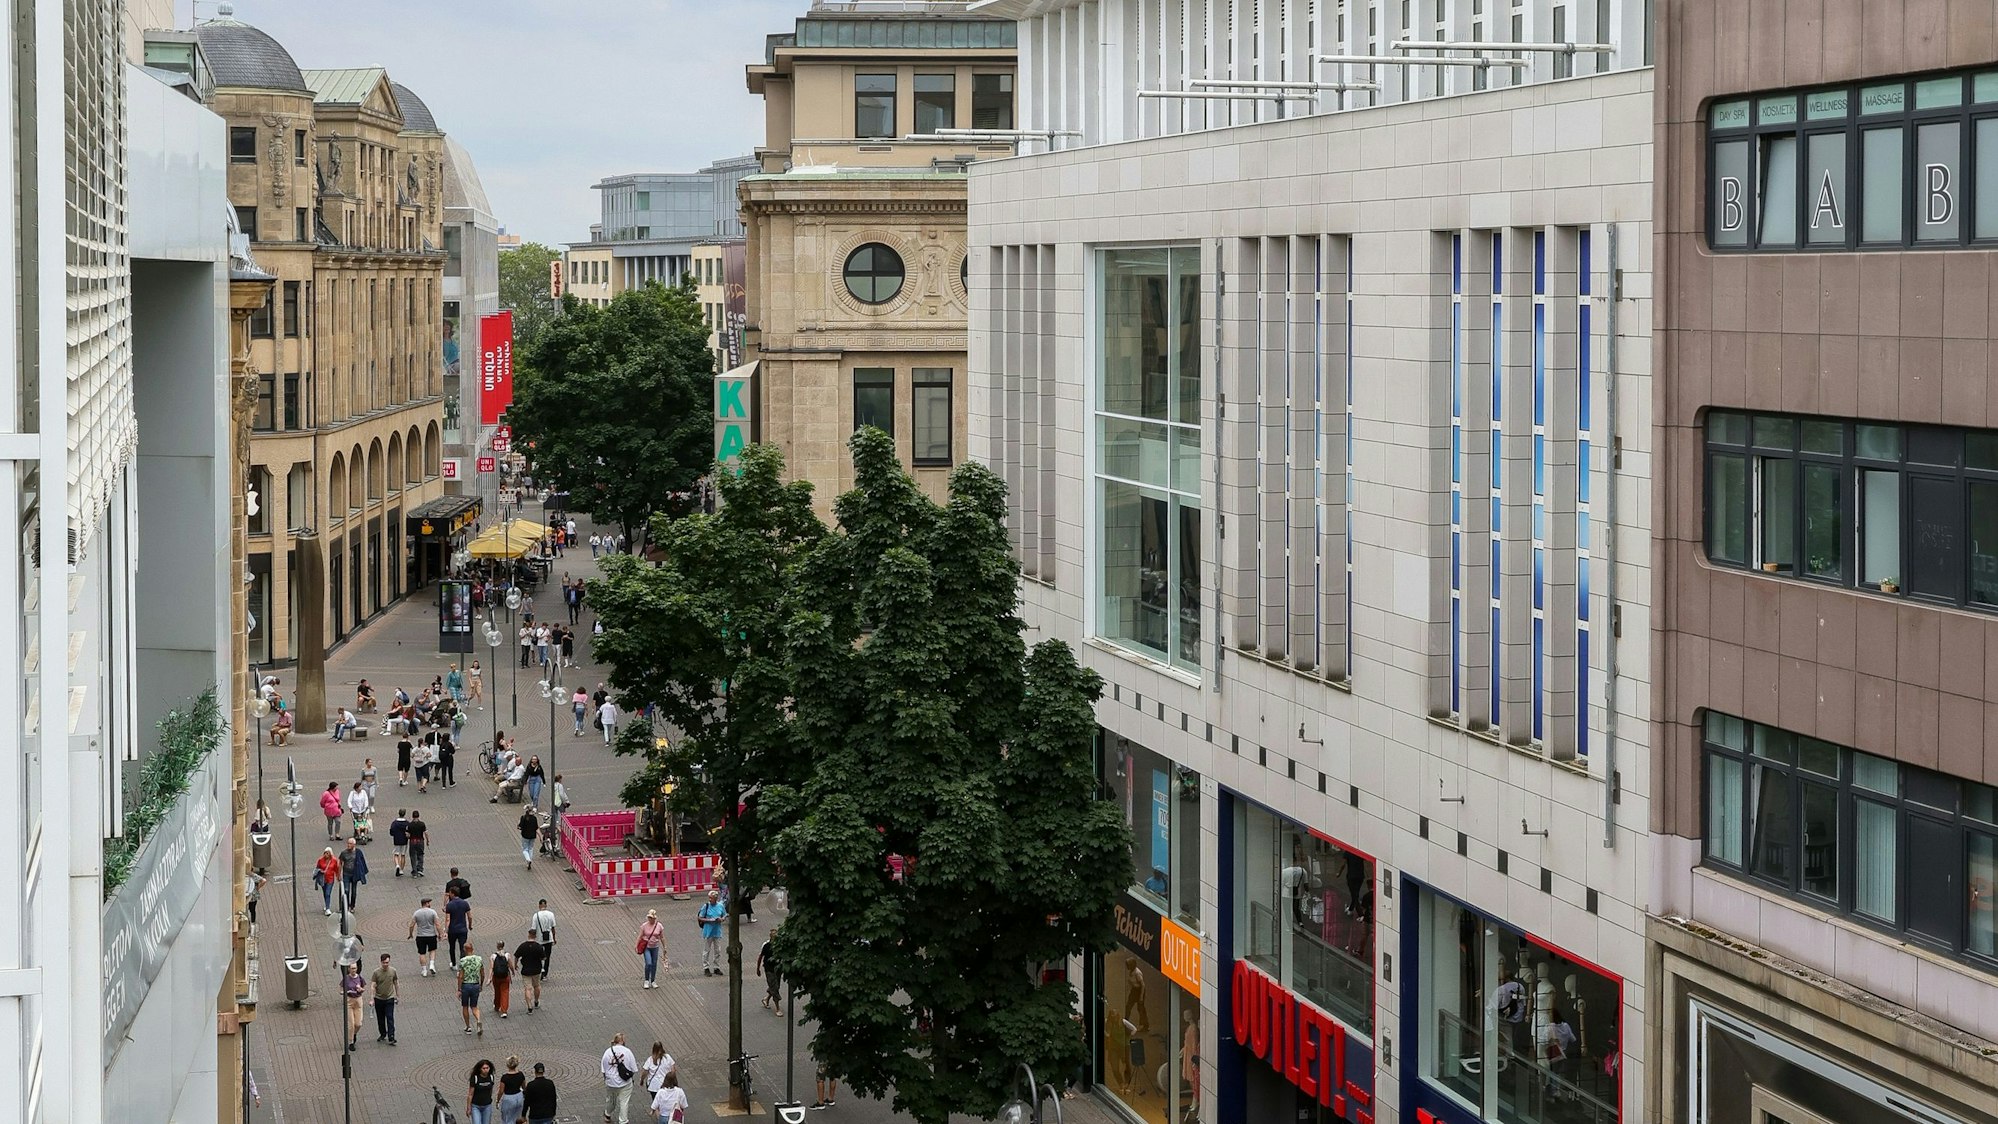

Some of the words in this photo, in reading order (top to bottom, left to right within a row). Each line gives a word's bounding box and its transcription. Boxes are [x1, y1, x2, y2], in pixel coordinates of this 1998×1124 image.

[1762, 103, 1797, 117] KOSMETIK
[1809, 99, 1848, 113] WELLNESS
[1865, 92, 1903, 107] MASSAGE
[1719, 110, 1731, 121] DAY
[1732, 108, 1746, 120] SPA
[484, 351, 495, 391] UNIQLO
[1114, 904, 1154, 951] Tchibo
[103, 972, 125, 1038] LEGEN
[1232, 959, 1346, 1119] OUTLET!
